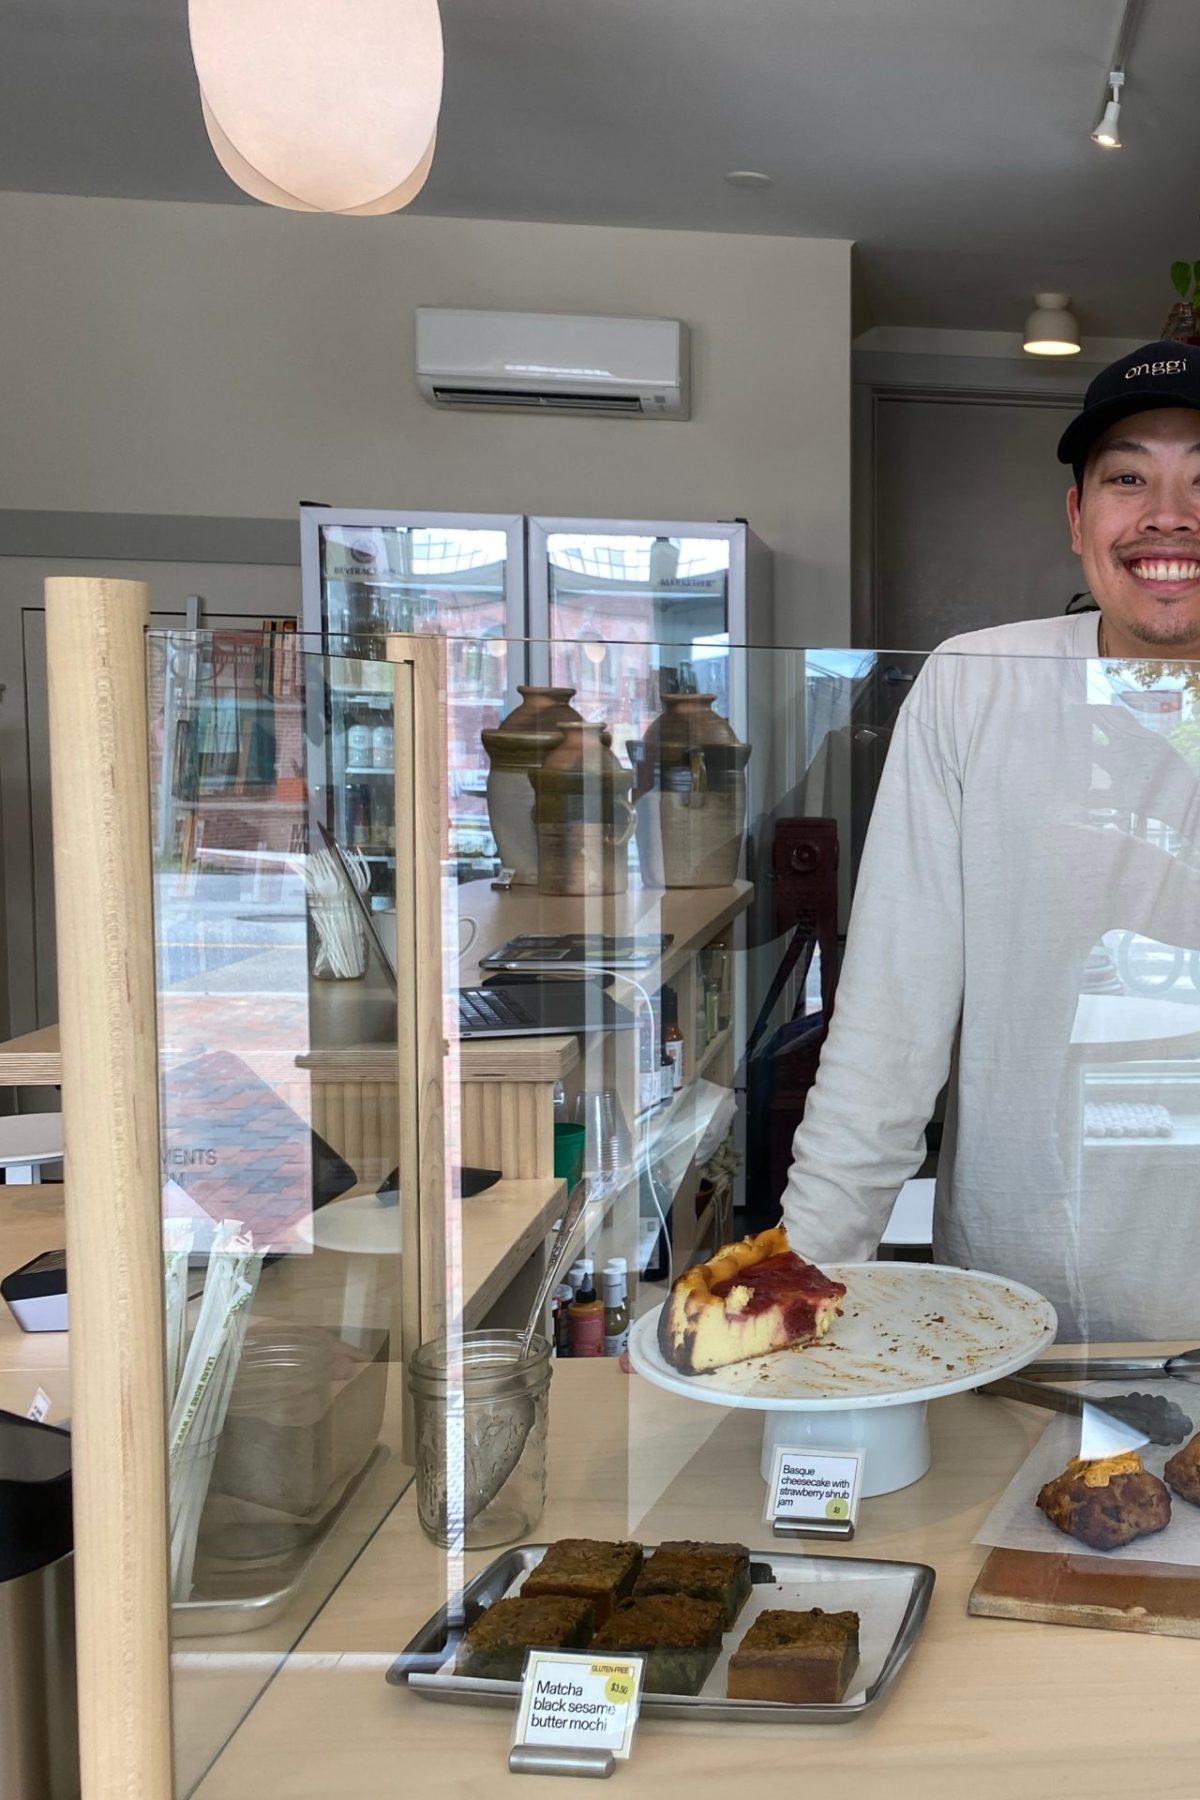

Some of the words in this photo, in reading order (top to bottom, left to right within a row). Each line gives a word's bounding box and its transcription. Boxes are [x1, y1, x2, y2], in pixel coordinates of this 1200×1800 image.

[1125, 358, 1187, 379] onggi
[783, 1464, 815, 1477] Basque
[781, 1476, 831, 1487] cheesecake
[832, 1480, 850, 1488] with
[779, 1487, 825, 1500] strawberry
[825, 1490, 850, 1499] shrub
[777, 1497, 793, 1508] jam
[536, 1680, 583, 1696] Matcha
[610, 1682, 628, 1695] $3.50
[533, 1697, 567, 1712] black
[568, 1704, 616, 1715] sesame
[530, 1713, 568, 1729] butter
[569, 1717, 607, 1732] mochi
